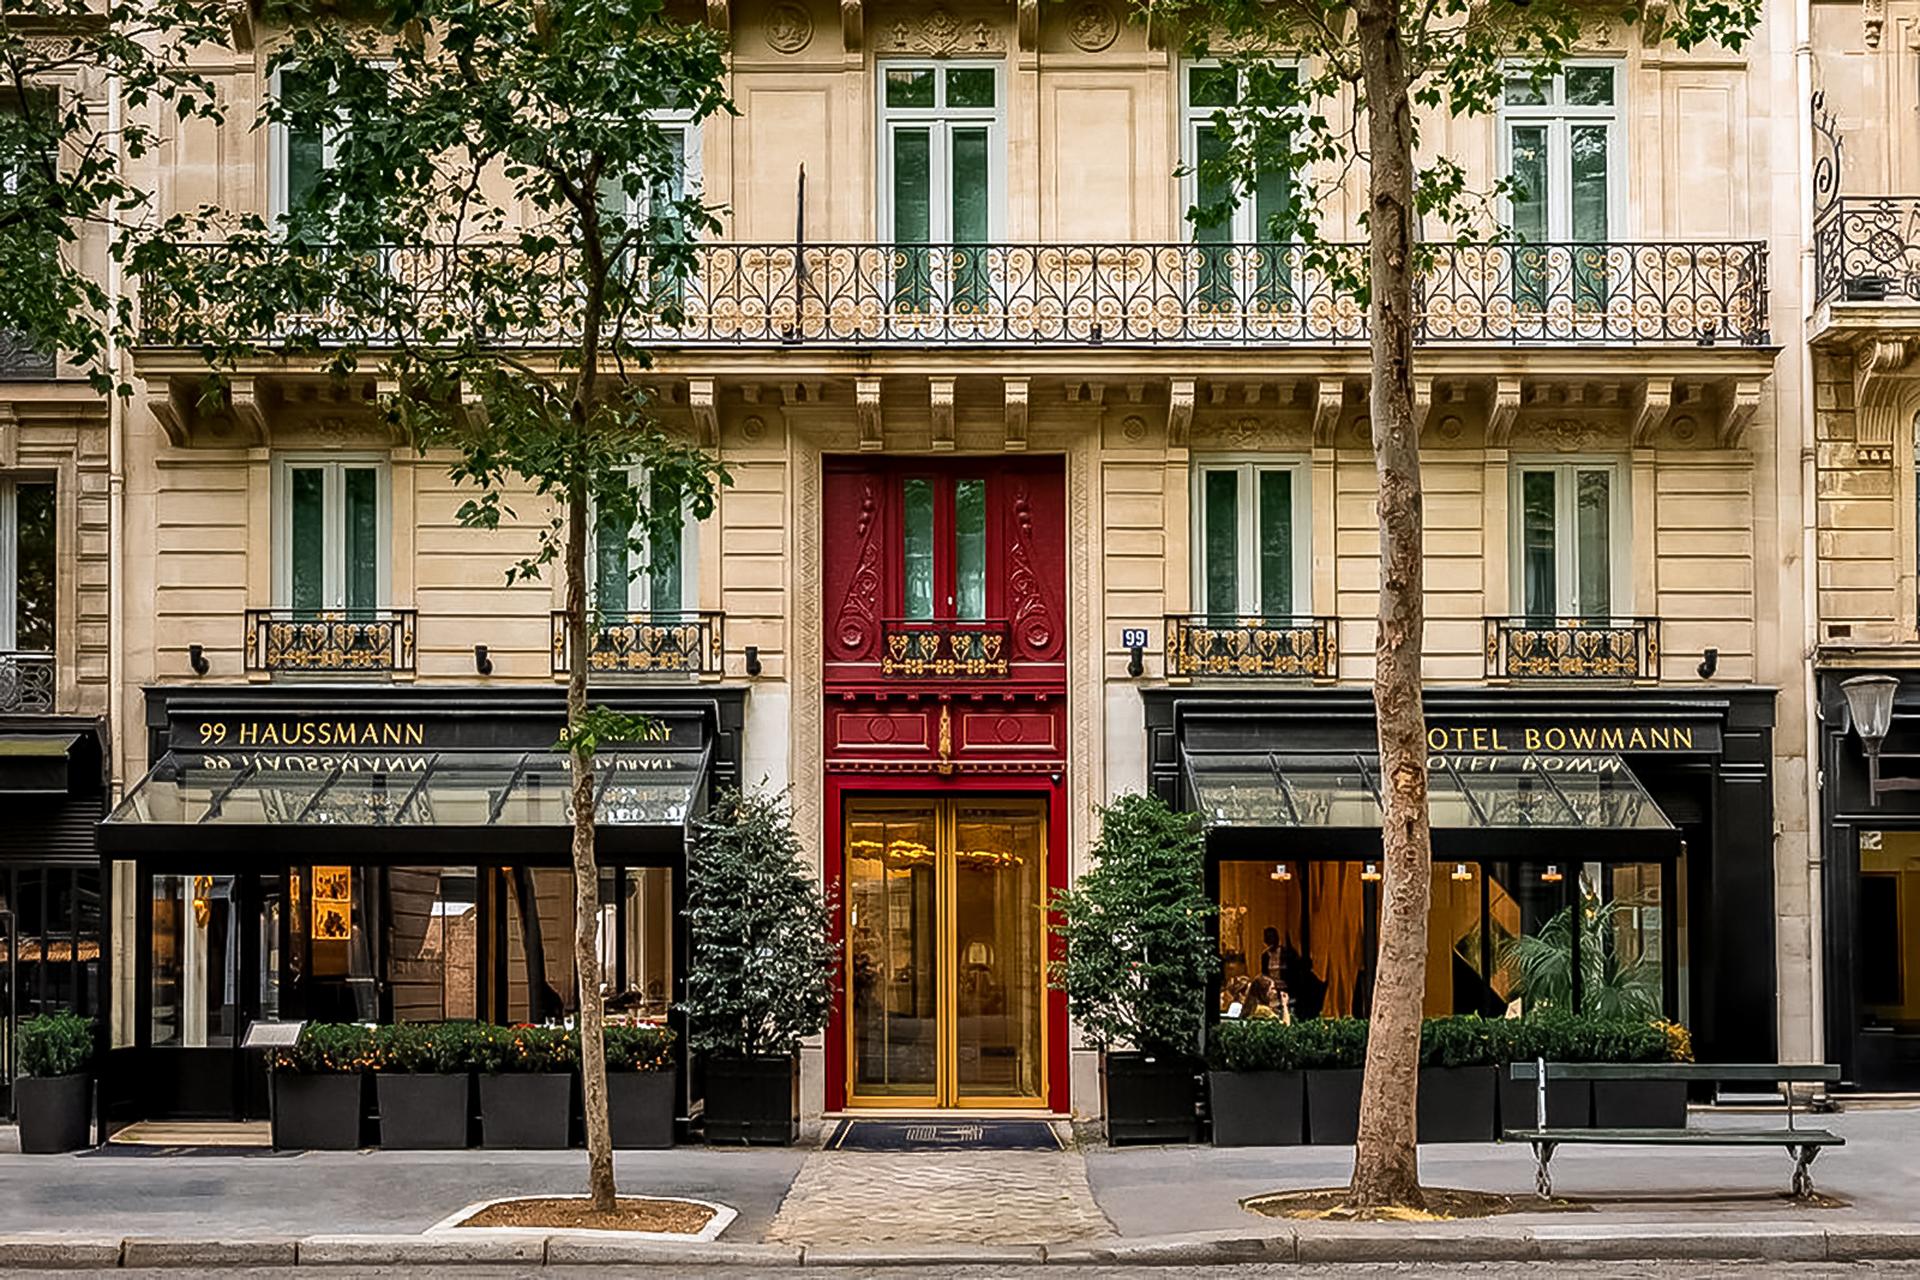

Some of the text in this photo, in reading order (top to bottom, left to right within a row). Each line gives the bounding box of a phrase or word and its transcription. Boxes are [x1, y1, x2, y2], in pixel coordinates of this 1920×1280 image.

[1125, 630, 1145, 646] 99
[200, 722, 424, 745] 99 HAUSSMANN
[1428, 727, 1693, 750] OTEL BOWMANN
